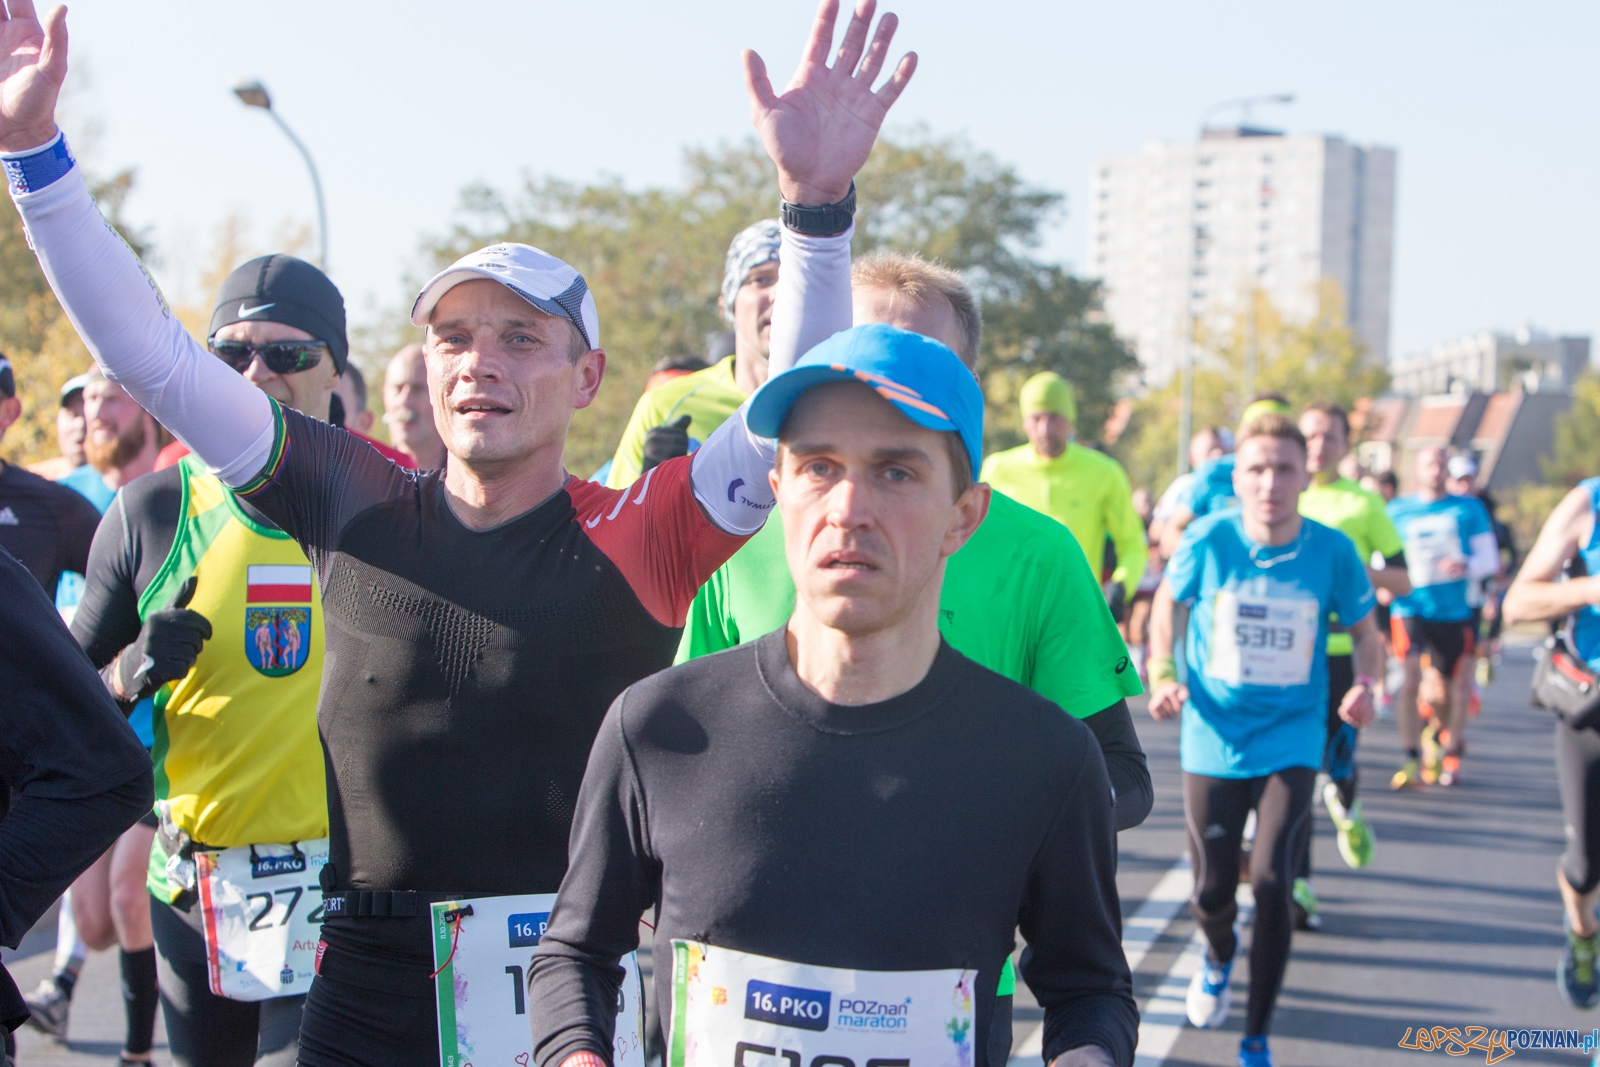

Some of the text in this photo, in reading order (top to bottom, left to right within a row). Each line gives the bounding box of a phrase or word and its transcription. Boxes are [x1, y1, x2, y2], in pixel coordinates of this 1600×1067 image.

[514, 923, 536, 937] 16.
[752, 991, 823, 1019] 16. PKO
[838, 1015, 907, 1028] maraton
